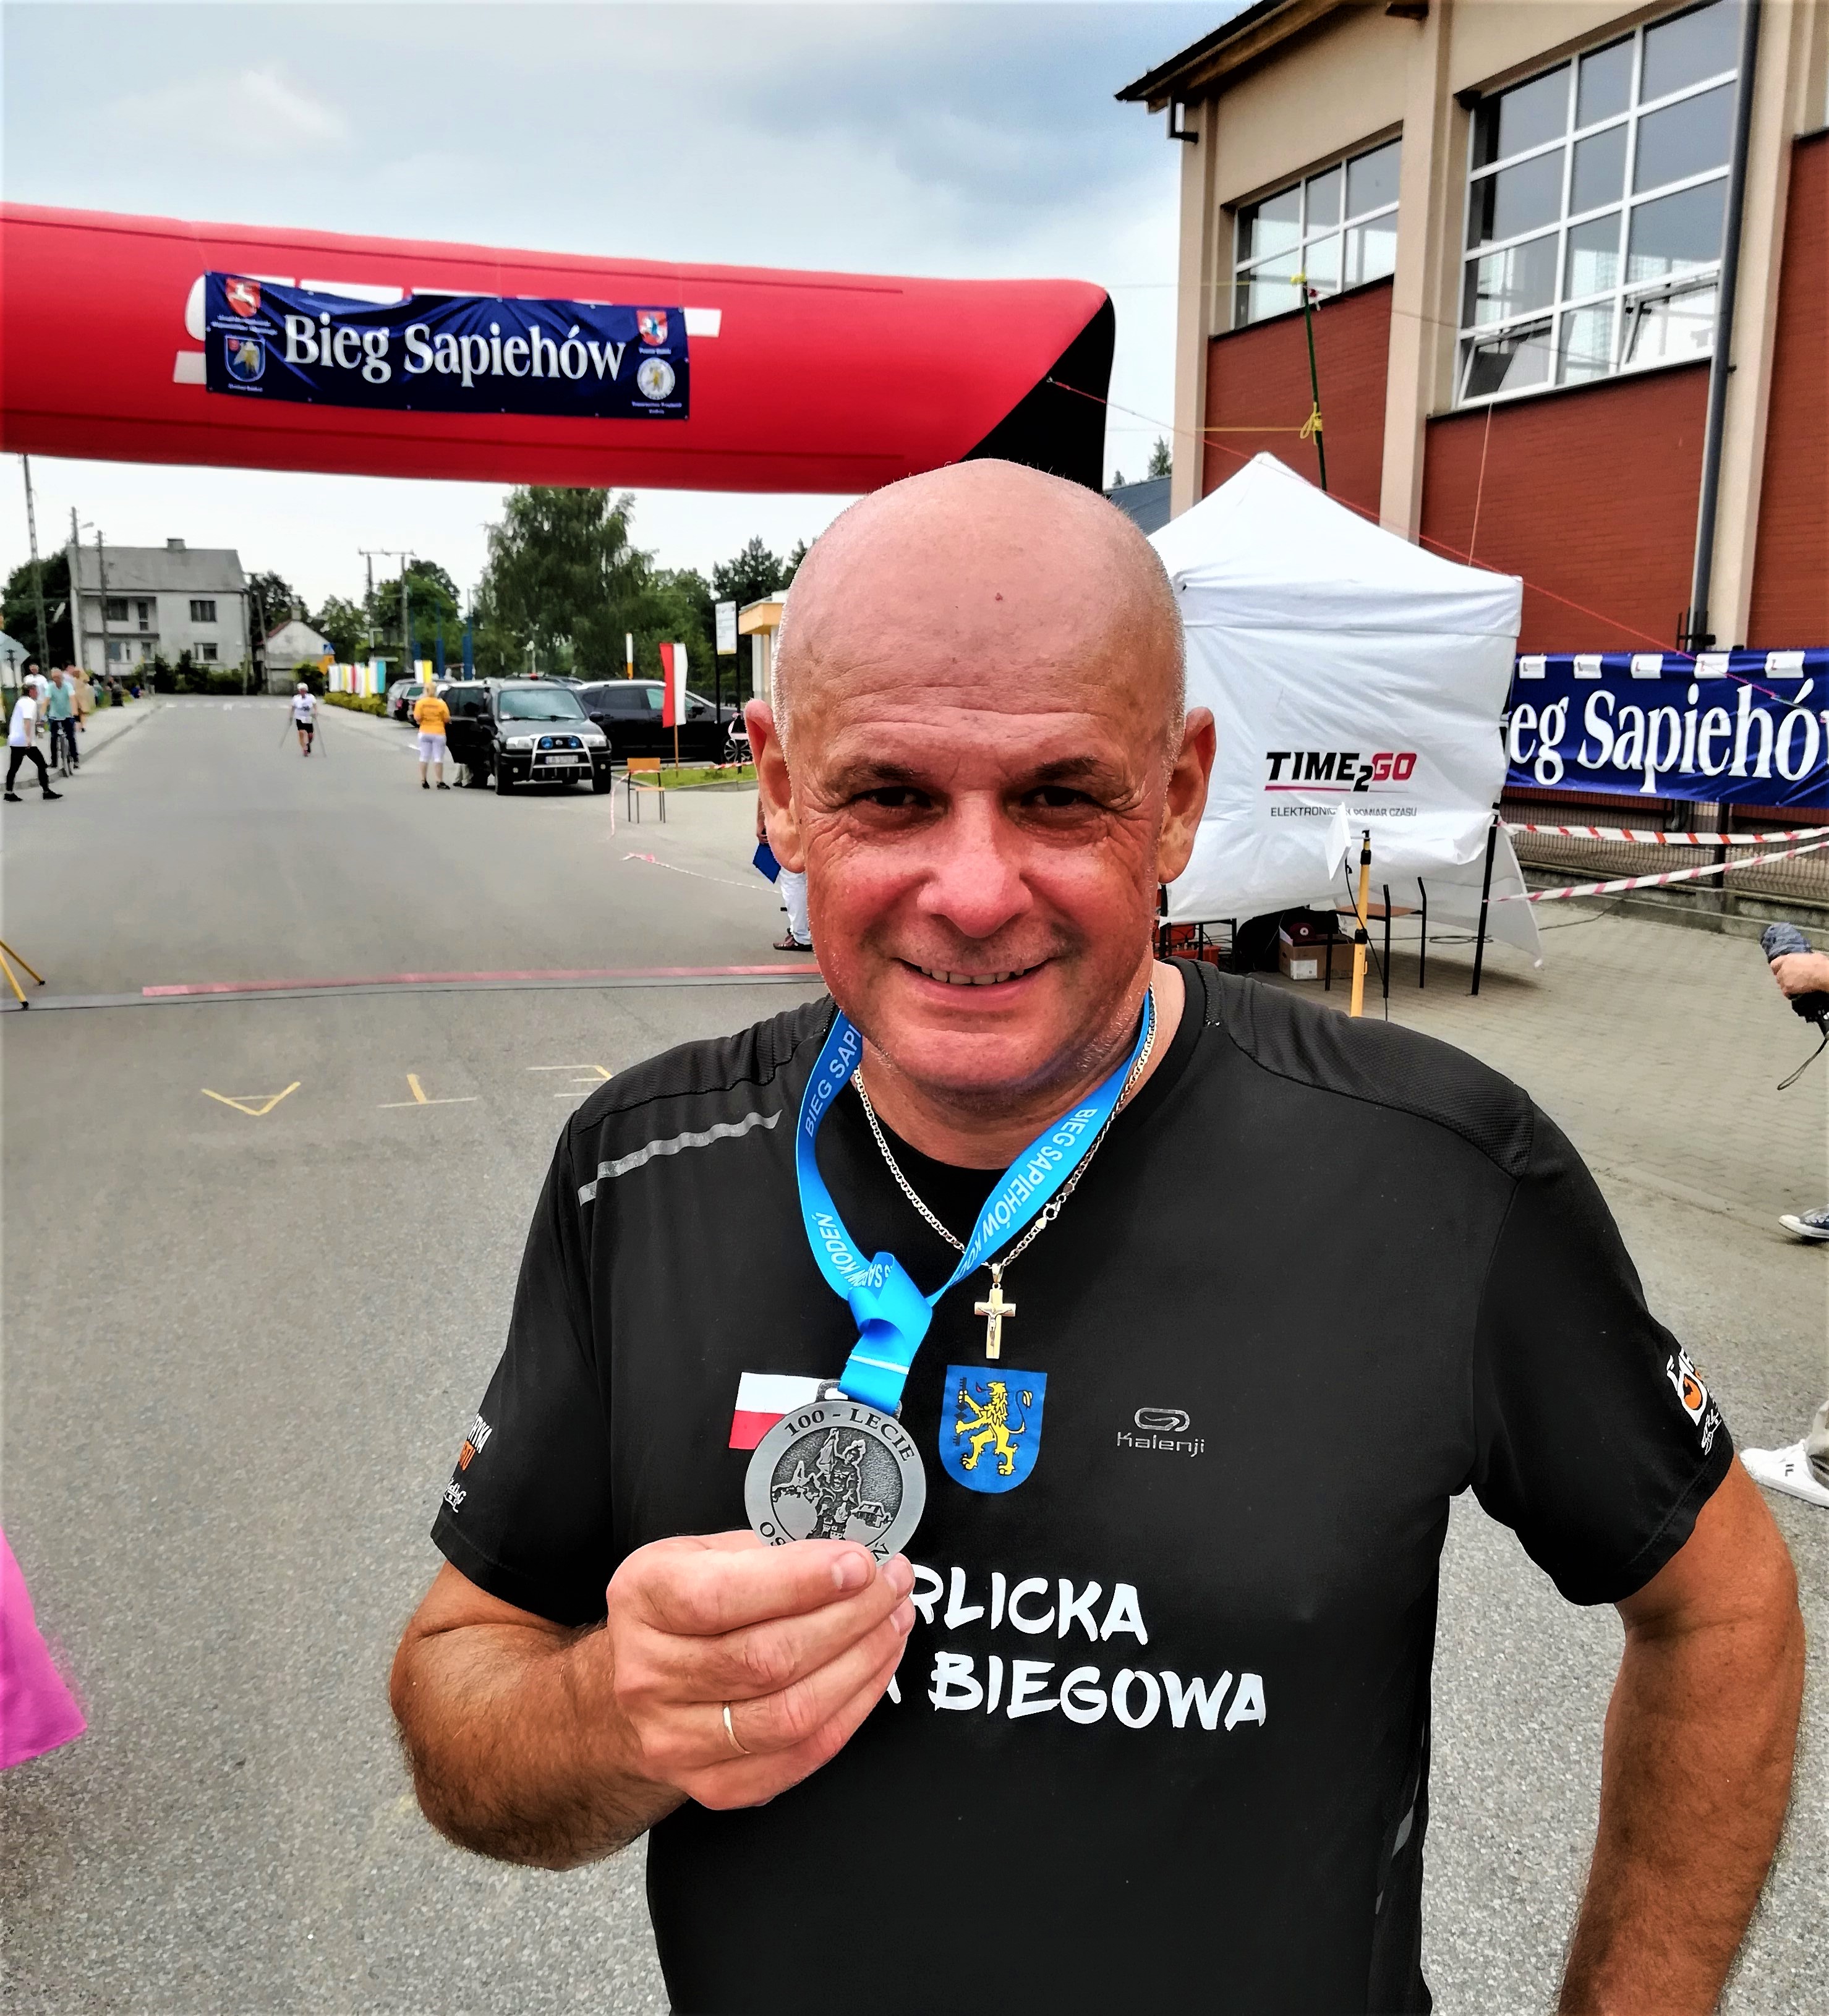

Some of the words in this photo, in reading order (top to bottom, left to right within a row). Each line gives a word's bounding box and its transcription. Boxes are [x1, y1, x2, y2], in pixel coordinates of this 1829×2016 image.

[284, 312, 390, 383] Bieg
[403, 323, 626, 388] Sapiehów
[1509, 695, 1569, 786] eg
[1577, 678, 1829, 794] Sapiehó
[1266, 751, 1417, 792] TIME2GO
[1271, 806, 1351, 817] ELEKTRONICY
[1354, 807, 1388, 817] POMIAR
[1389, 806, 1417, 817] CZASU
[805, 1079, 832, 1138] BIEG
[829, 1023, 862, 1079] SAPI
[1052, 1108, 1099, 1147] BIEG
[983, 1146, 1064, 1244] SAPIEHÓW
[811, 1212, 861, 1275] KODEŃ
[784, 1410, 825, 1437] 100
[849, 1408, 916, 1461] LECIE
[1117, 1431, 1205, 1458] Kalenji
[910, 1563, 1148, 1646] RLICKA
[928, 1651, 1266, 1731] BIEGOWA
